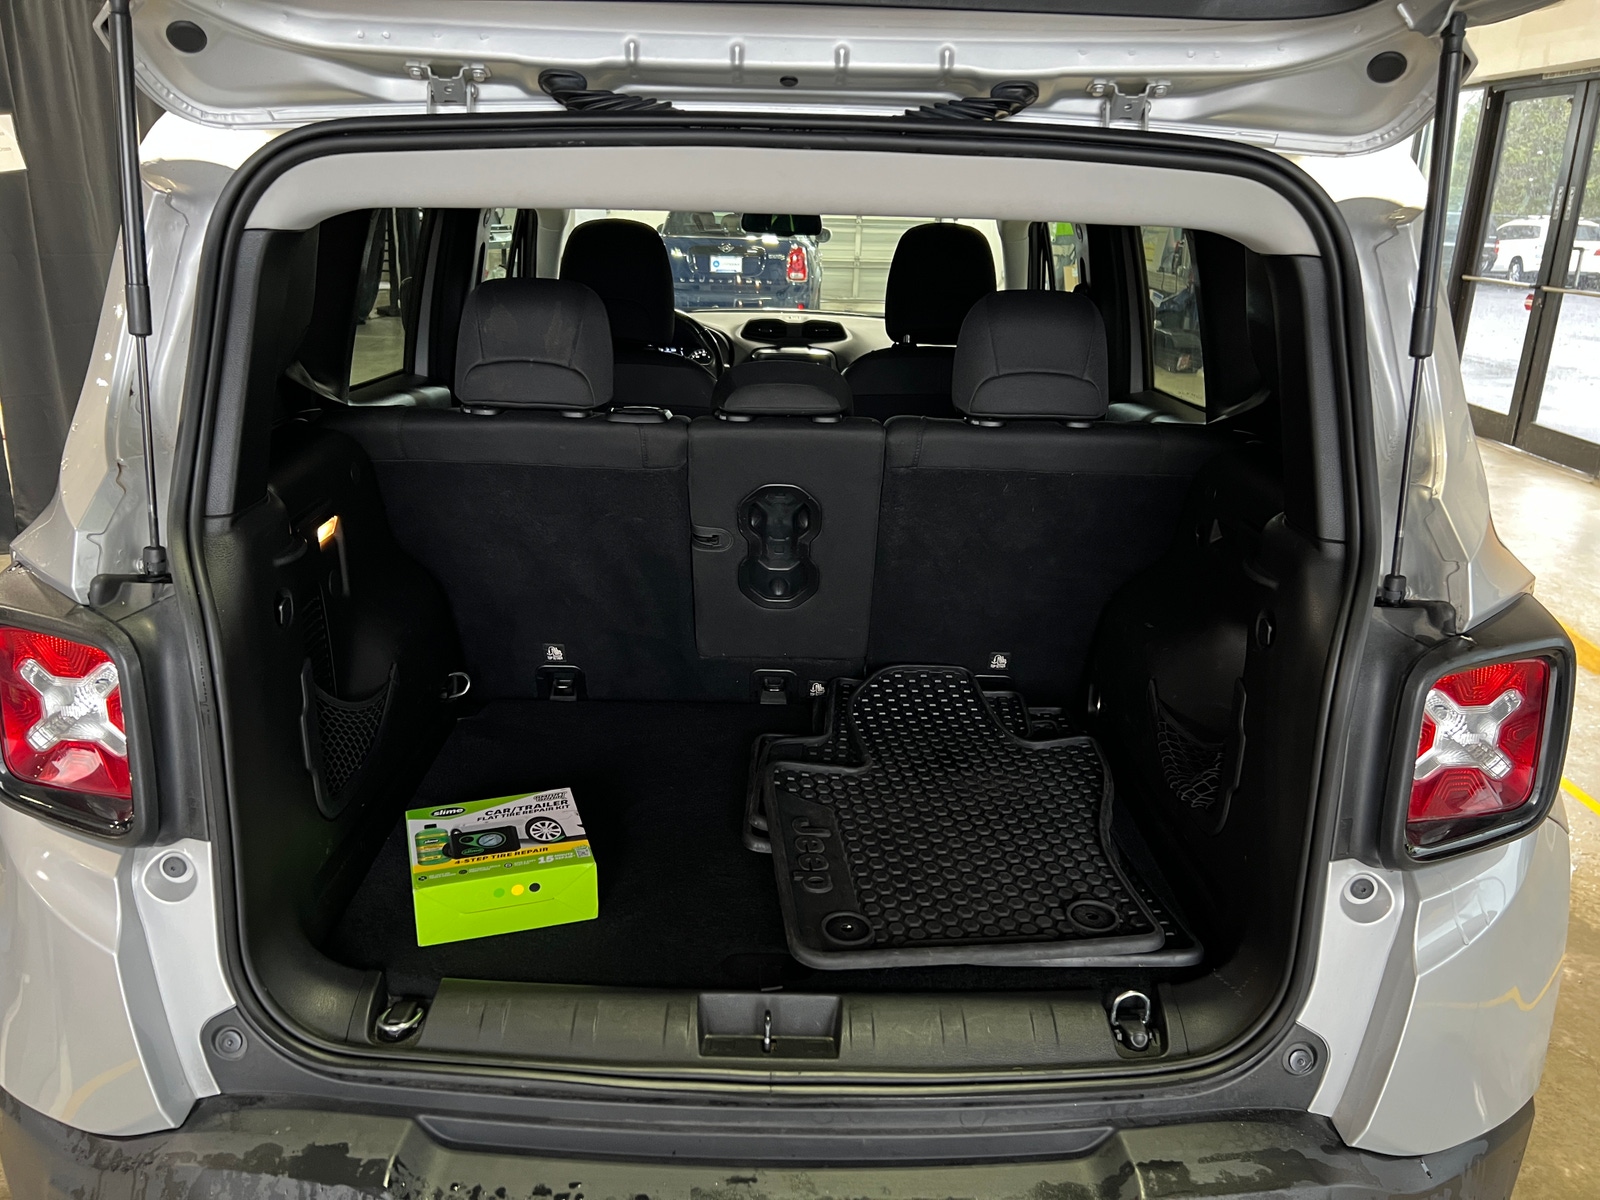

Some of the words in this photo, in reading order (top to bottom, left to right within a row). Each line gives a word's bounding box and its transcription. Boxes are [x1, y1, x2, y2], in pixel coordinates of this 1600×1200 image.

[433, 808, 464, 816] slime
[477, 814, 500, 822] FLAT
[522, 807, 554, 815] REPAIR
[485, 800, 568, 816] CAR/TRAILER
[454, 856, 489, 865] 4-STEP
[491, 852, 513, 860] TIRE
[514, 847, 549, 856] REPAIR
[792, 816, 834, 894] Jeep
